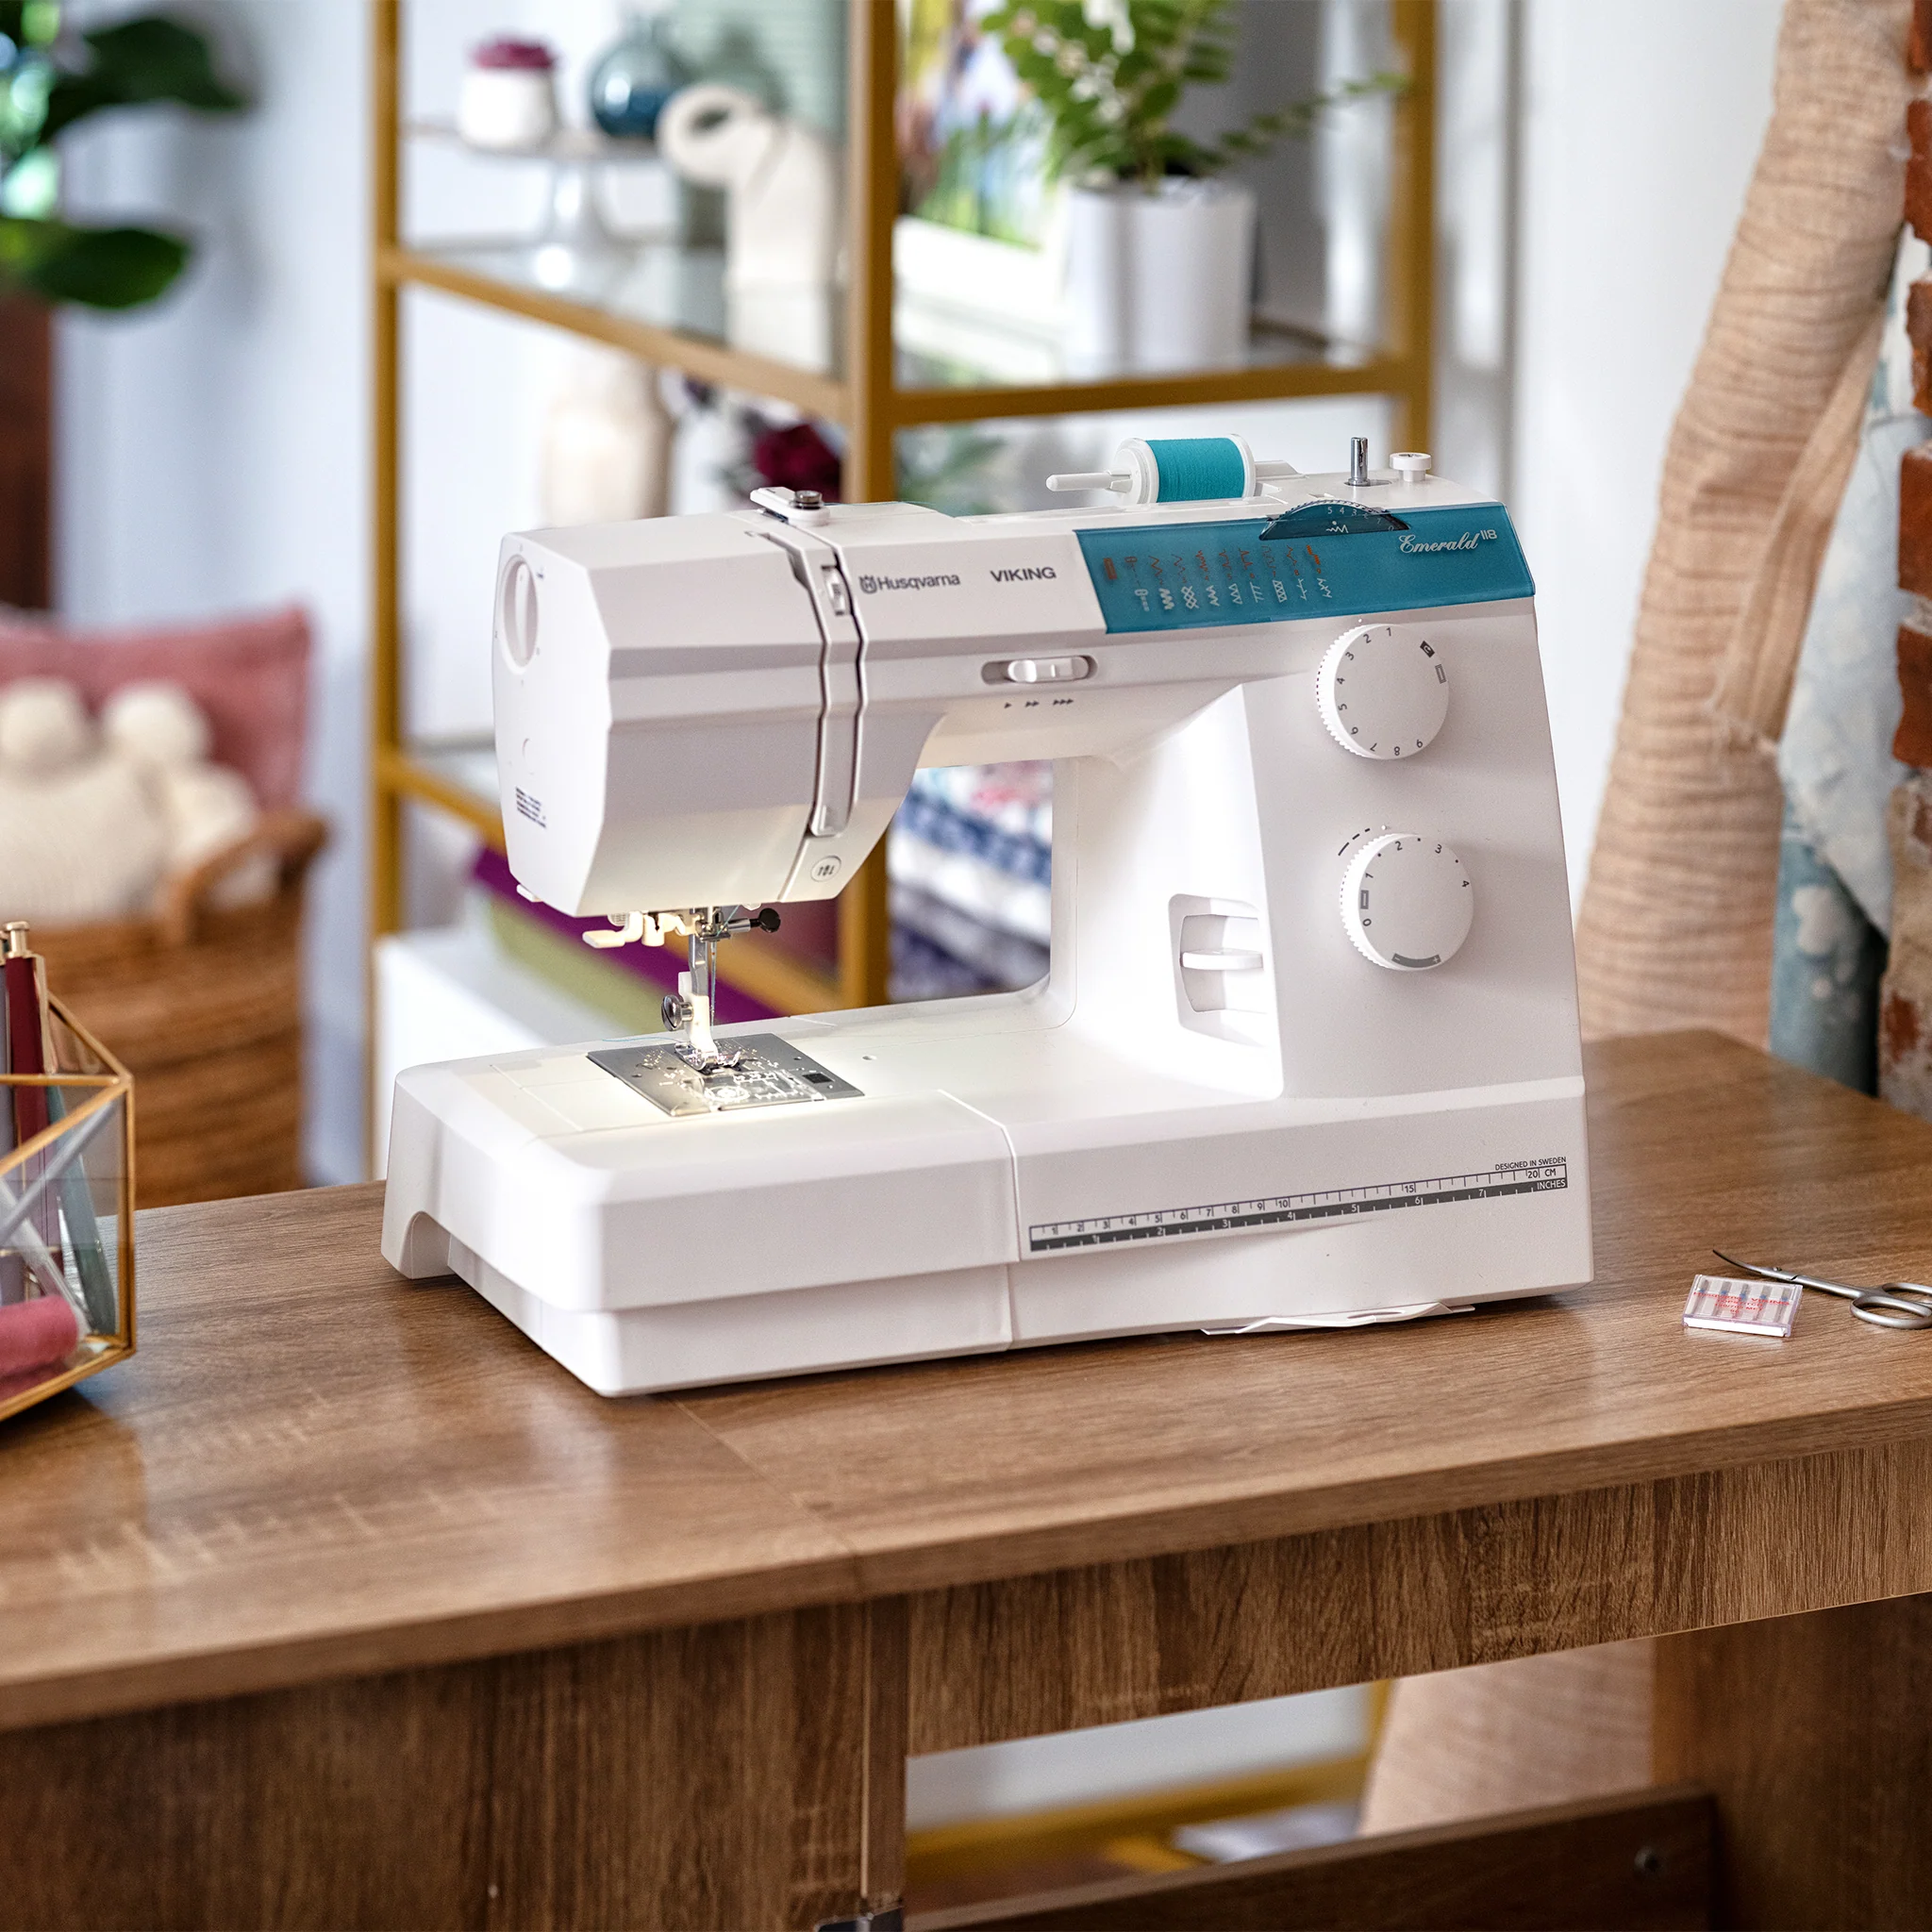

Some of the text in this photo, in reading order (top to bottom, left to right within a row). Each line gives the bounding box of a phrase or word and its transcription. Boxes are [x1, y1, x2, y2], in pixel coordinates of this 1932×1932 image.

[1398, 529, 1497, 554] Emerald 118
[877, 567, 1057, 591] Husqvarna VIKING
[1386, 627, 1391, 637] 1
[1363, 634, 1372, 643] 2
[1345, 652, 1355, 660] 3
[1351, 726, 1358, 735] 6
[1370, 742, 1377, 752] 7
[1394, 746, 1400, 756] 8
[1362, 918, 1372, 926] 0
[1395, 841, 1403, 851] 2
[1435, 844, 1442, 854] 3
[1494, 1160, 1528, 1171] DESIGNED
[1538, 1157, 1567, 1166] SWEDEN
[1180, 1211, 1186, 1220] 6
[1206, 1208, 1211, 1217] 7
[1231, 1206, 1237, 1214] 8
[1257, 1202, 1262, 1210] 9
[1278, 1199, 1289, 1208] 10
[1405, 1185, 1414, 1193] 15
[1528, 1170, 1539, 1178] 20
[1544, 1168, 1557, 1177] CM
[1157, 1227, 1163, 1236] 2
[1287, 1211, 1292, 1220] 4
[1352, 1204, 1357, 1212] 5
[1415, 1196, 1421, 1205] 6
[1478, 1189, 1484, 1197] 7
[1537, 1178, 1566, 1191] INCHES
